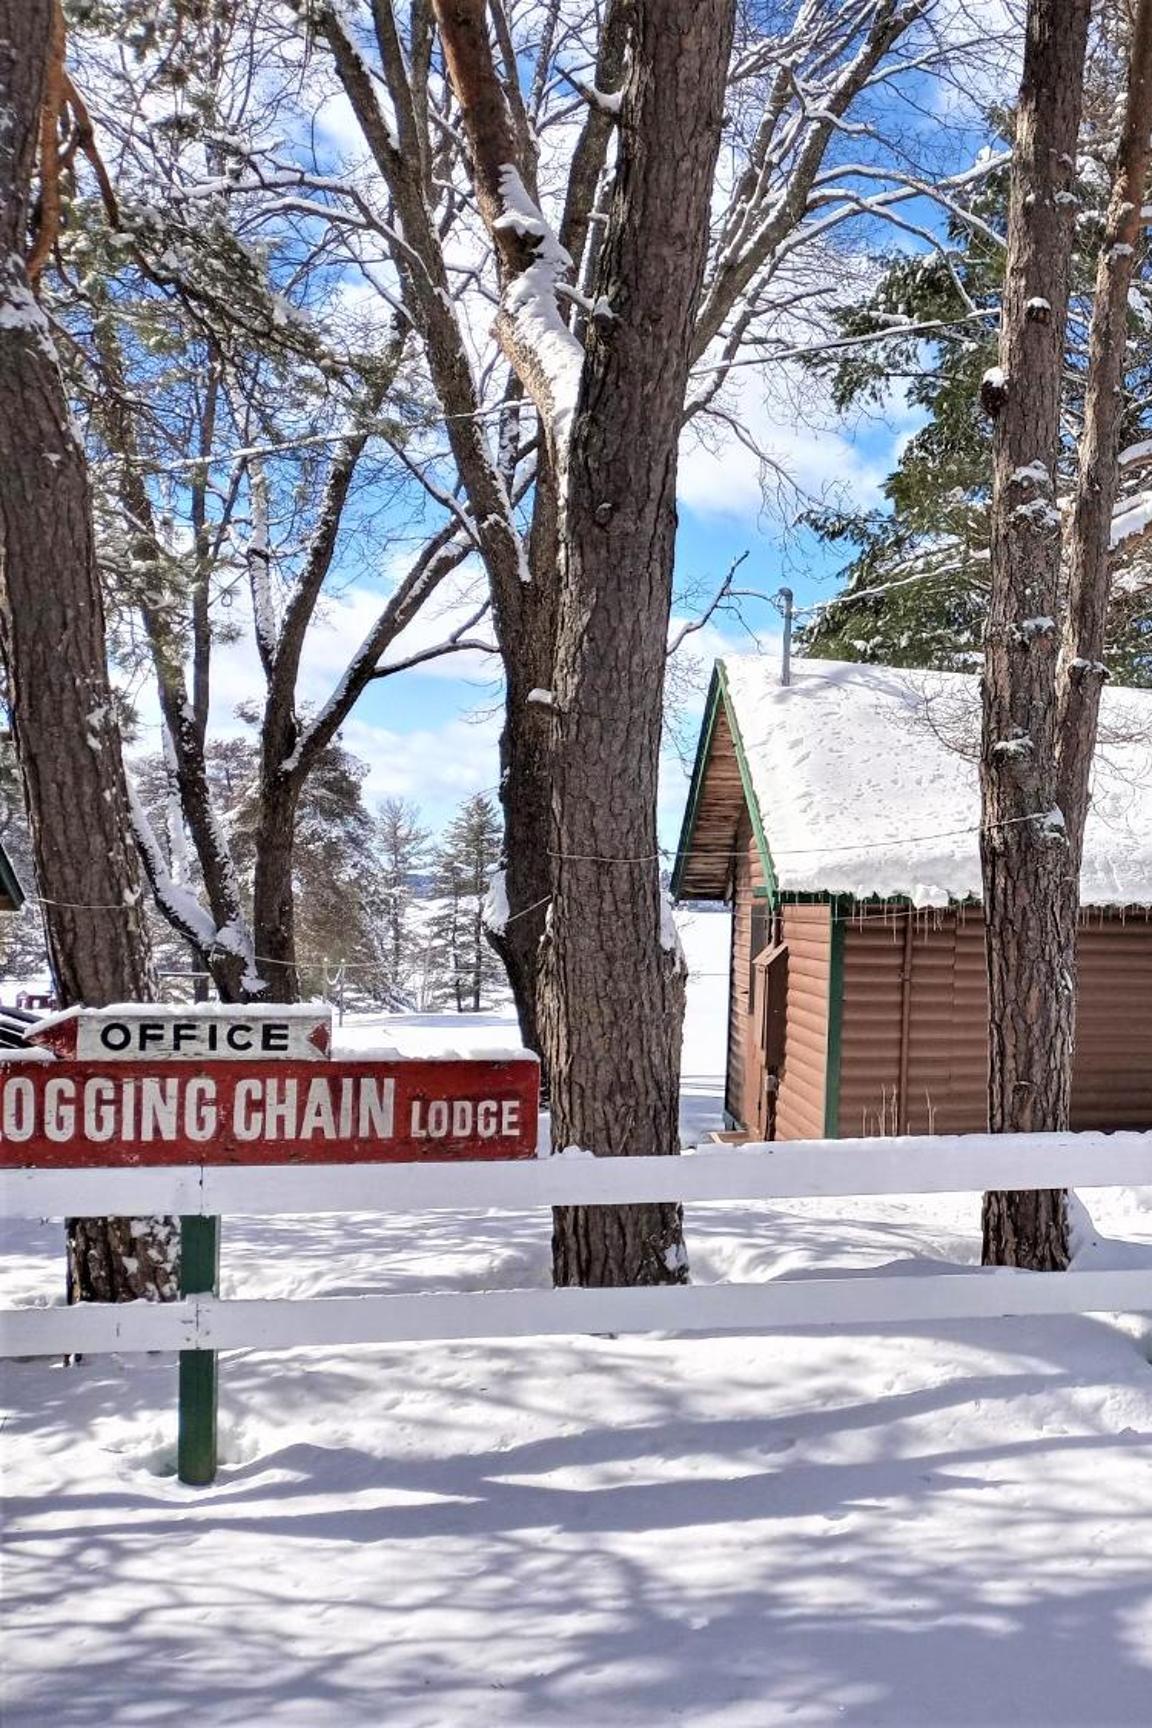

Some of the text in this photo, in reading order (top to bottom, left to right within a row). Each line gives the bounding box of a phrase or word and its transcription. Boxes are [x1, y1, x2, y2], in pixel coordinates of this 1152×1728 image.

[100, 1022, 289, 1051] OFFICE
[0, 1076, 521, 1142] OGGING CHAIN LODGE
